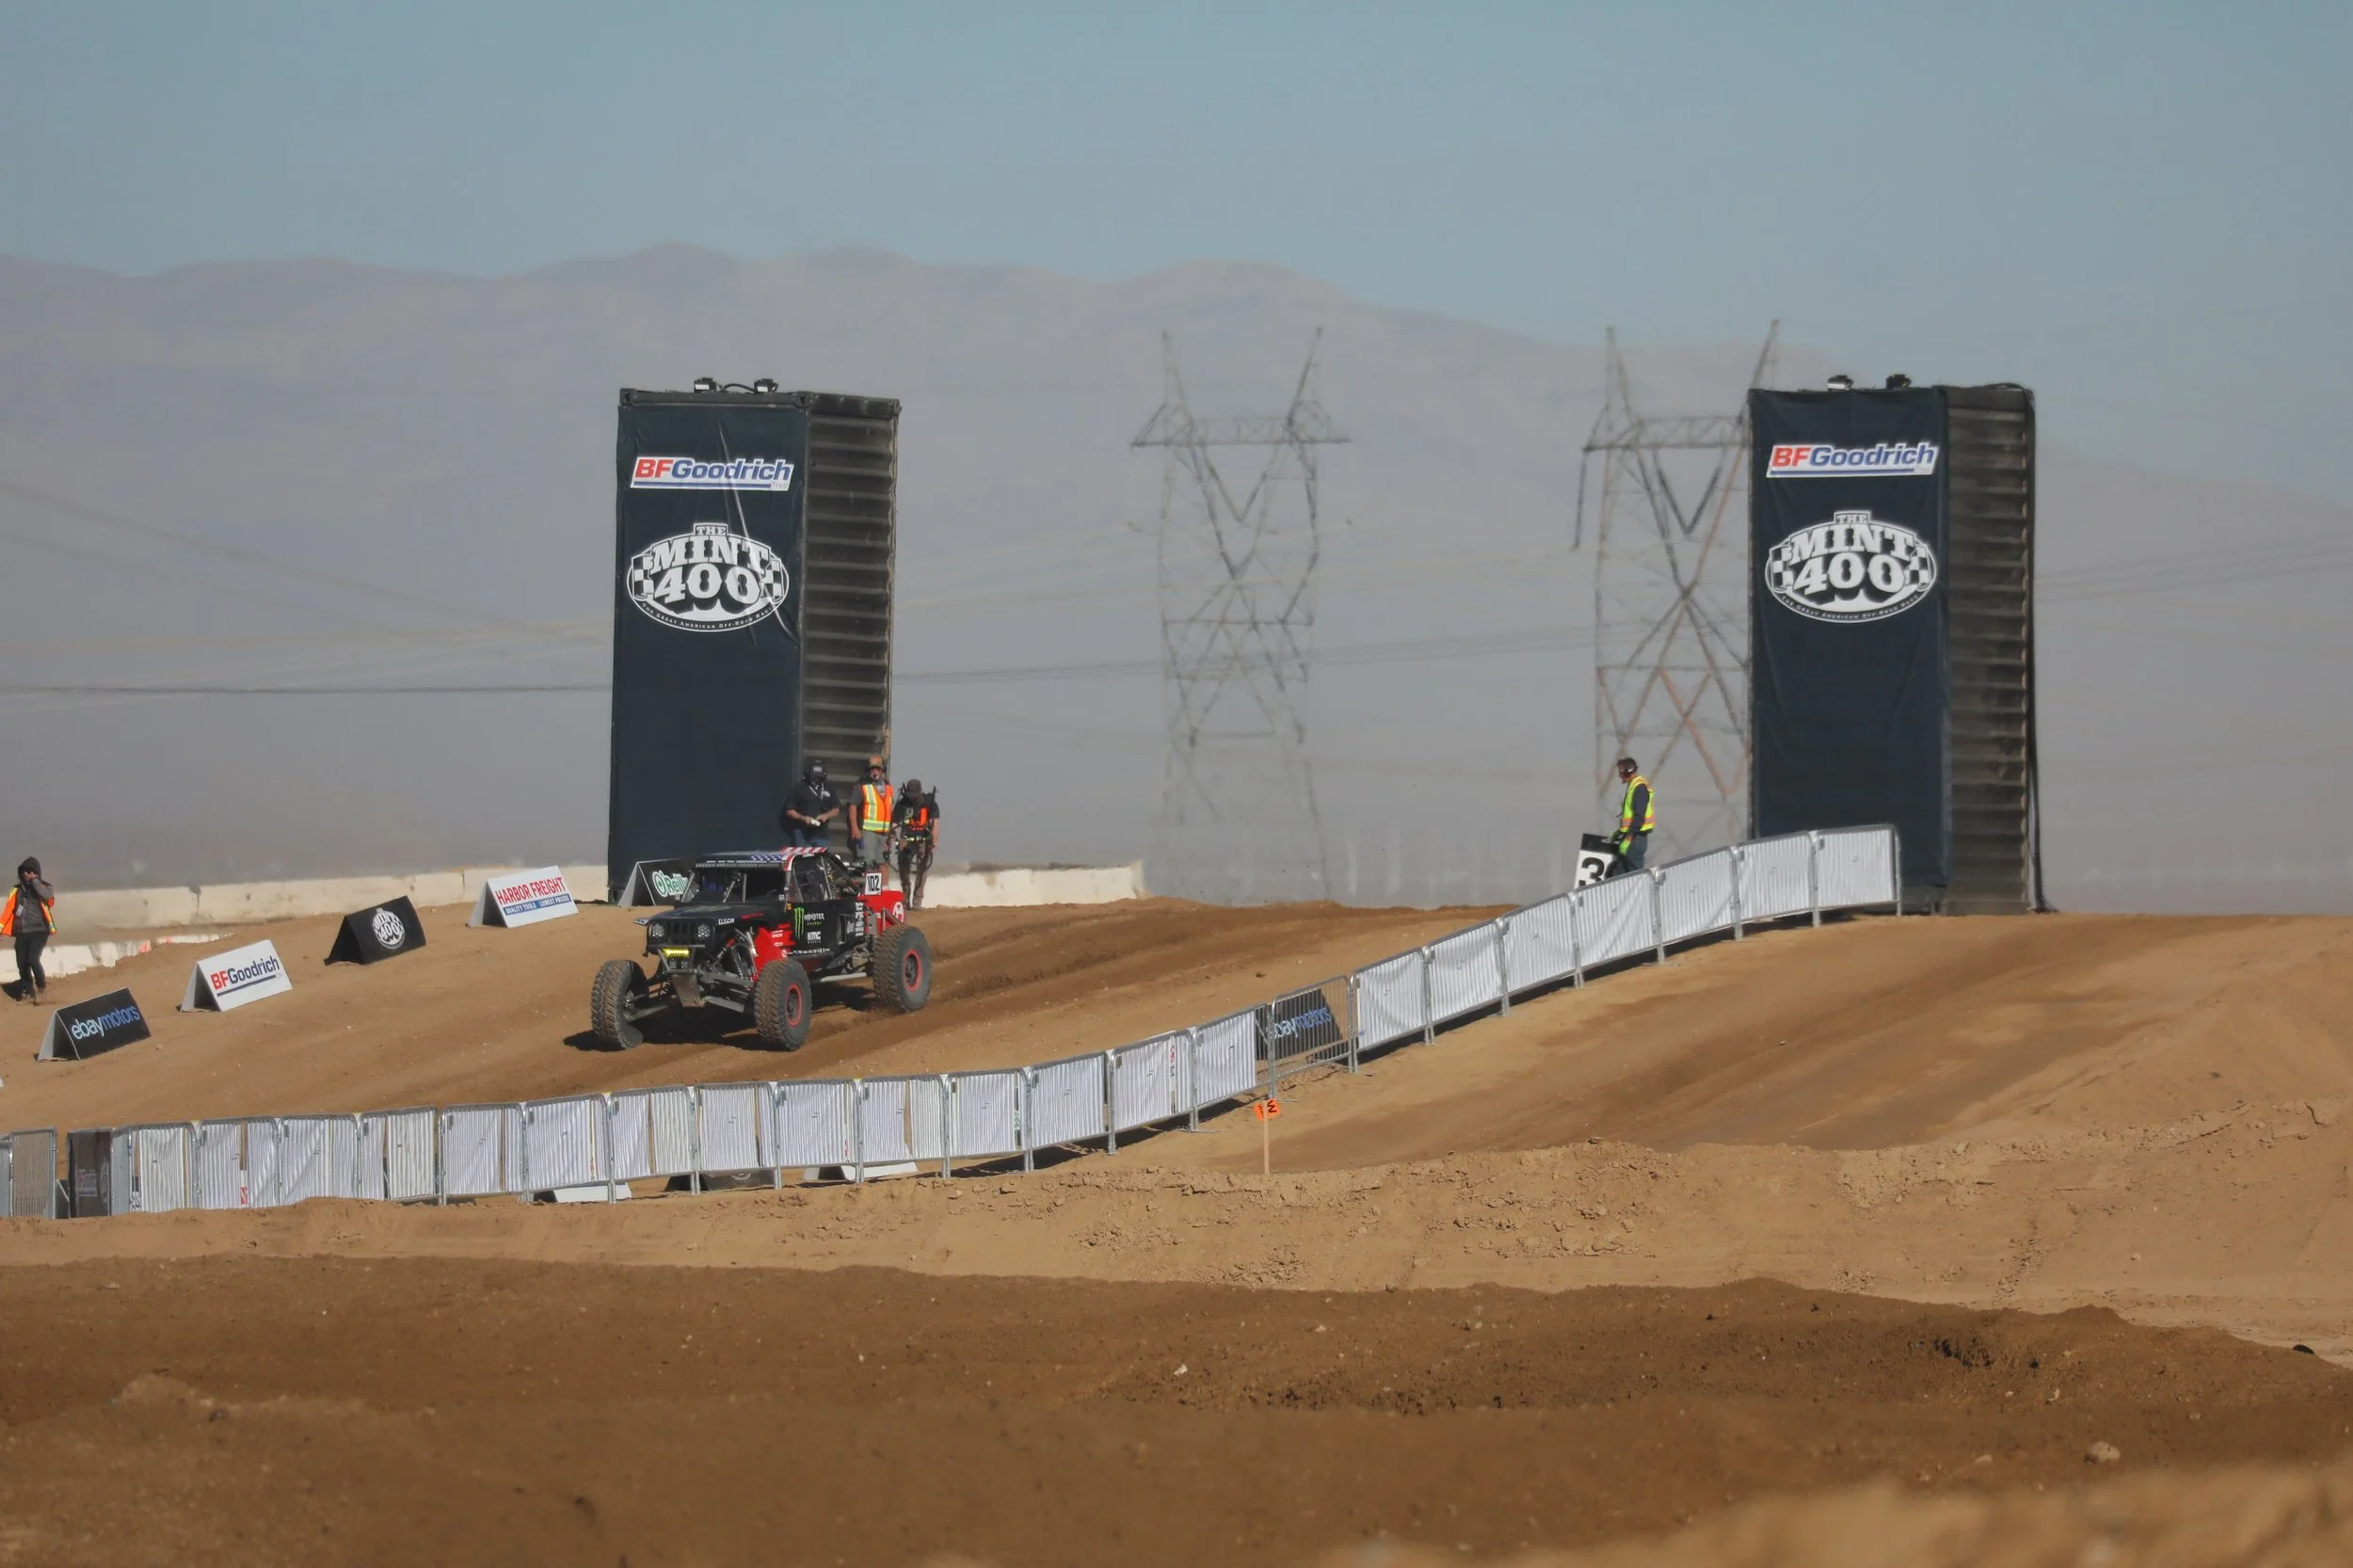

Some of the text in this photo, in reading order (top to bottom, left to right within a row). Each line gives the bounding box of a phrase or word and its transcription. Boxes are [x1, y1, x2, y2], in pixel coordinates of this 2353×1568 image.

[635, 459, 792, 481] BFGoodrich
[1771, 445, 1934, 467] BFGoodrich
[696, 526, 727, 536] THE
[1836, 515, 1867, 523] THE
[649, 536, 769, 575] MINT
[1789, 524, 1913, 566] MINT
[654, 564, 760, 603] 400
[1793, 552, 1905, 595] 400
[656, 613, 678, 624] GREAT
[680, 621, 715, 630] AMERICAN
[495, 877, 567, 905] HARBOR FREIGHT
[867, 875, 880, 891] 102
[211, 955, 280, 990] BFGoodrich
[1268, 1007, 1331, 1040] baymotors
